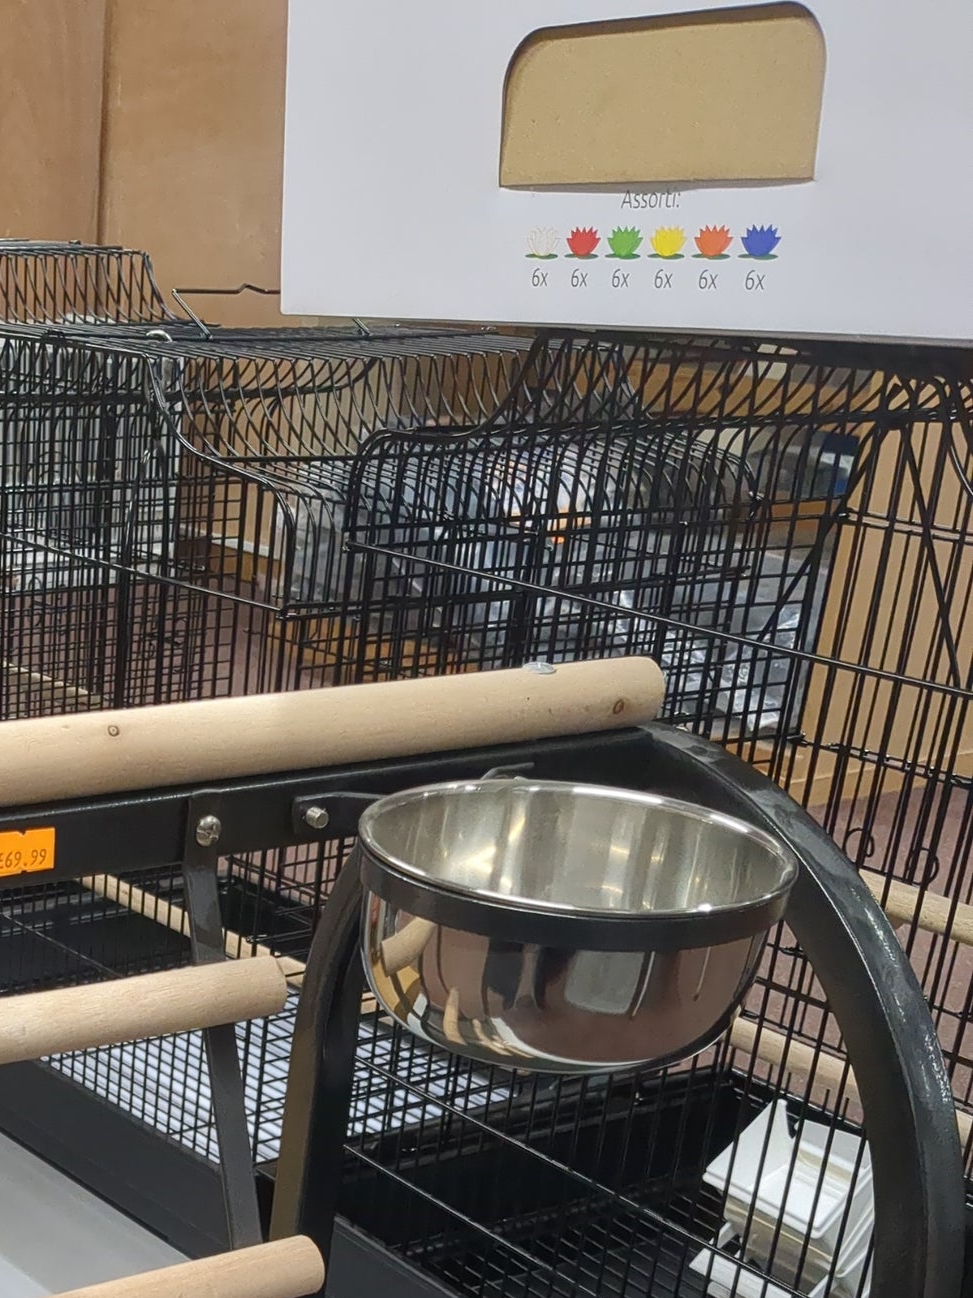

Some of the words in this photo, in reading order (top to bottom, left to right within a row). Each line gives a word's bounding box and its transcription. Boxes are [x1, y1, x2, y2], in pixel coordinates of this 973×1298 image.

[620, 189, 681, 209] Assorti:
[531, 267, 549, 287] 6x
[570, 268, 588, 288] 6x
[611, 268, 630, 288] 6x
[654, 268, 673, 289] 6x
[698, 269, 719, 290] 6x
[744, 269, 766, 291] 6x
